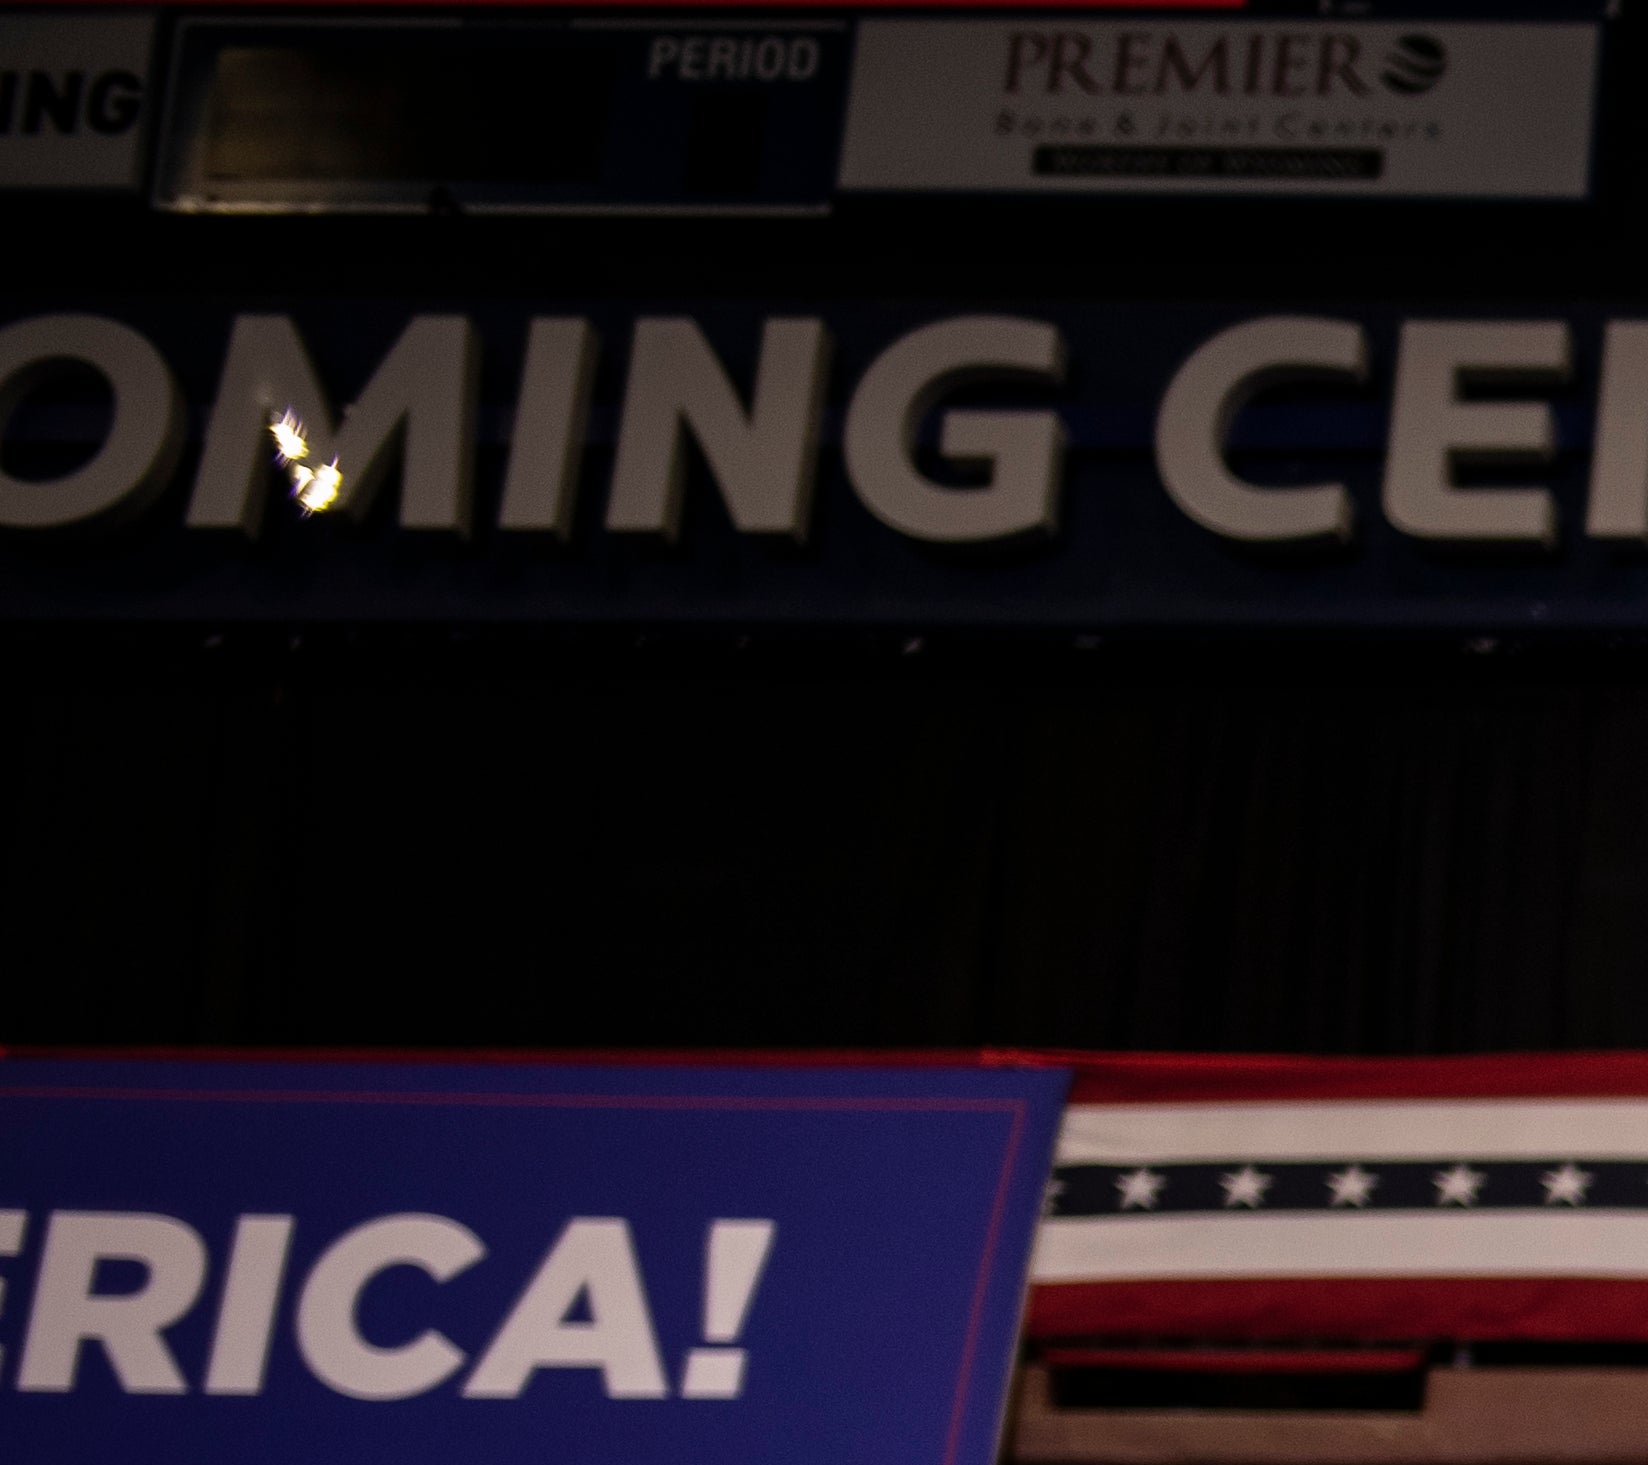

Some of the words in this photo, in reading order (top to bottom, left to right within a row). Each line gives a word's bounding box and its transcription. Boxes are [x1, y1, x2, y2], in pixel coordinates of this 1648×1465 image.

[645, 35, 822, 83] PERIOD
[1004, 31, 1371, 96] PREMIER
[0, 71, 141, 133] ING
[0, 311, 1066, 542] OMING
[0, 1208, 777, 1402] RICA!
